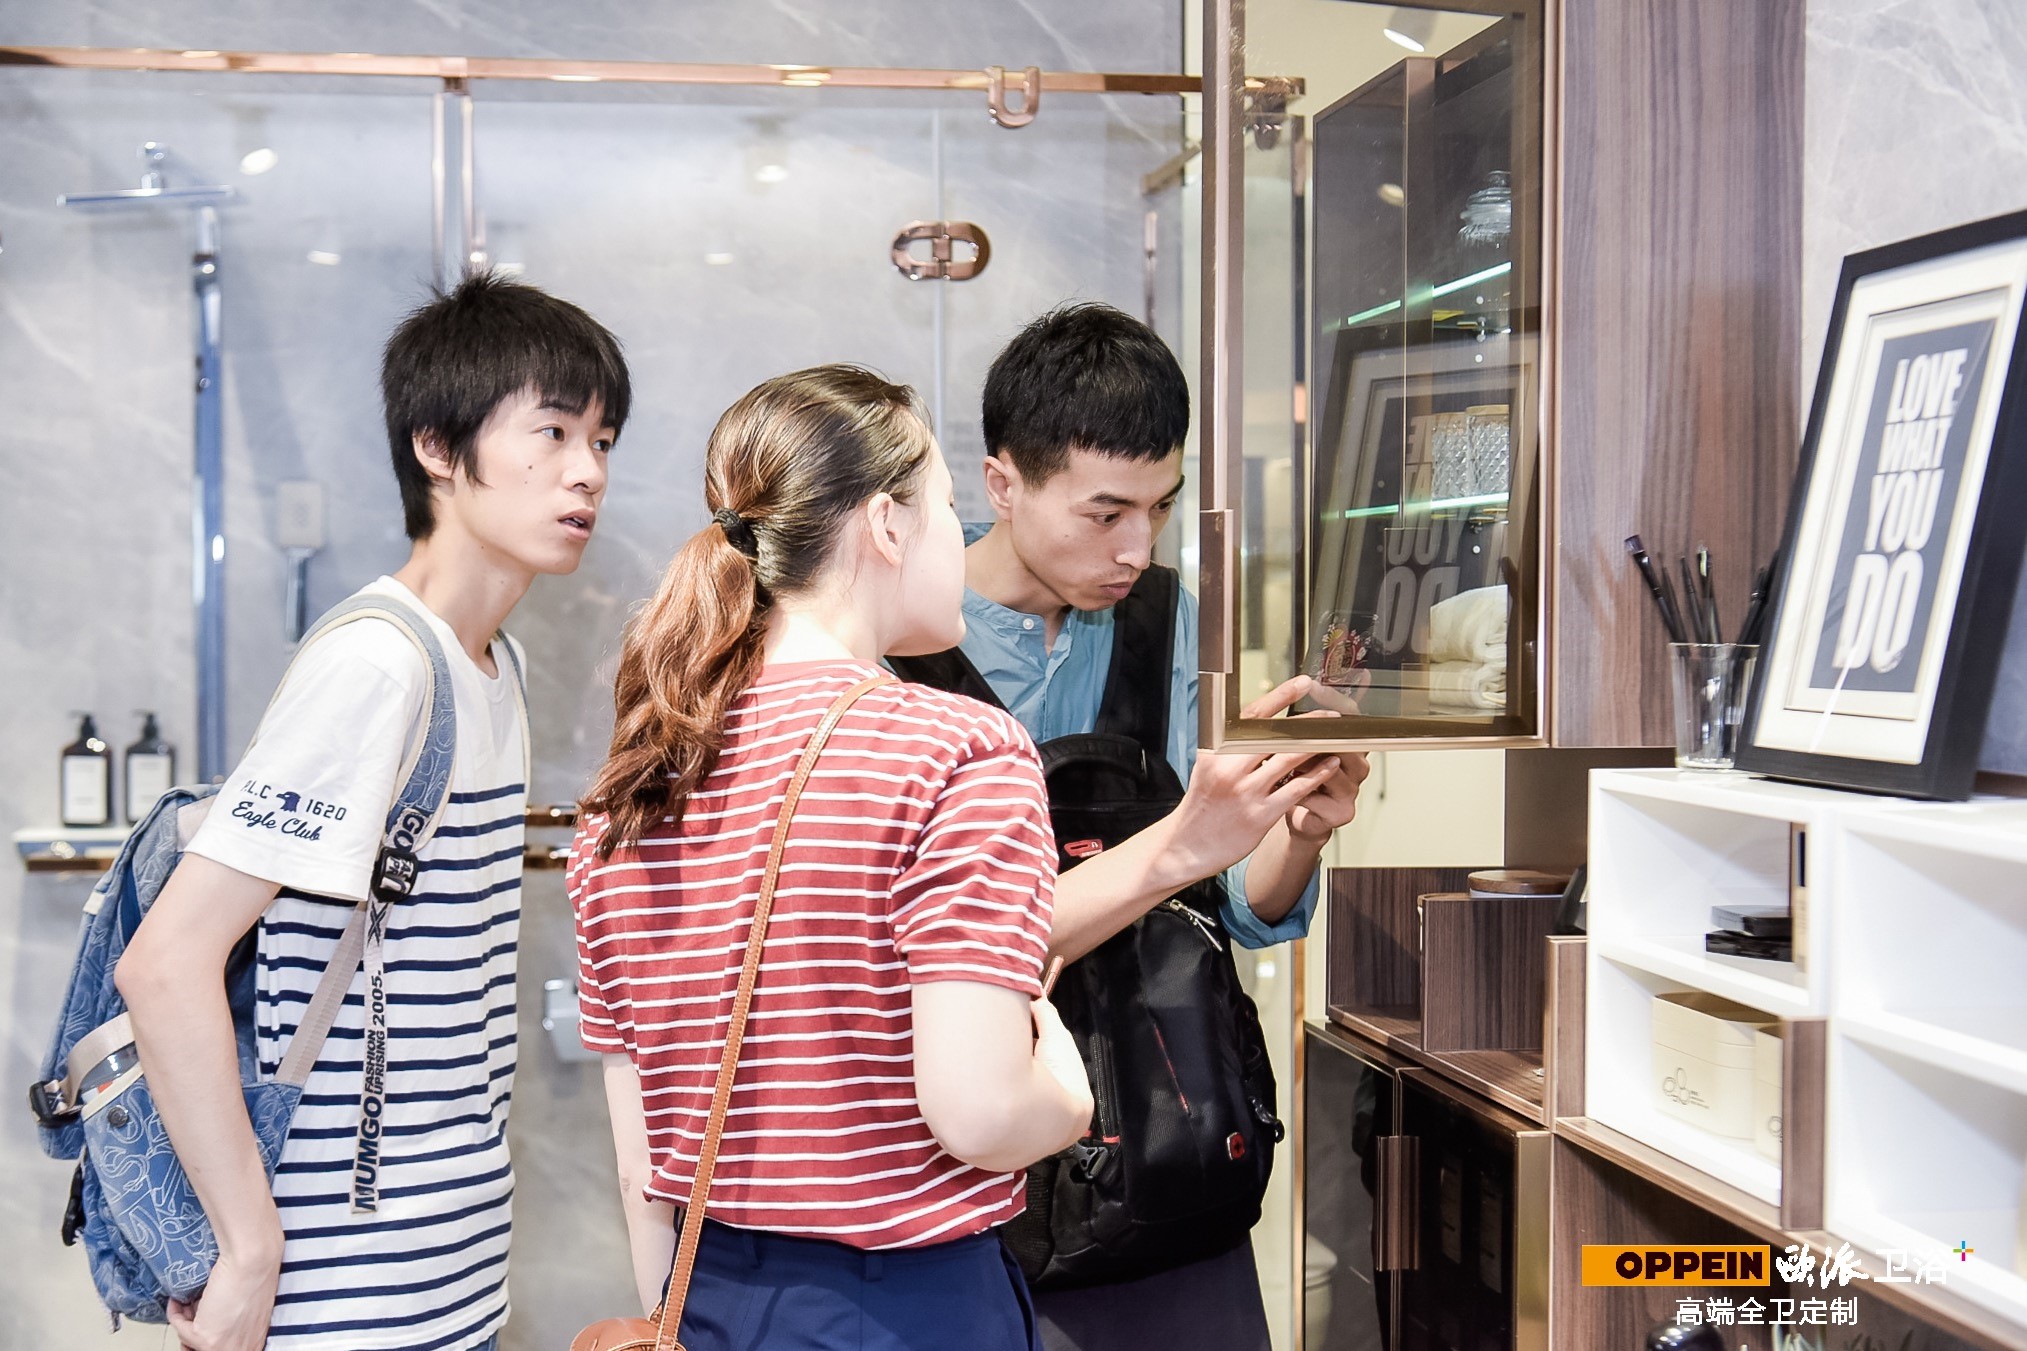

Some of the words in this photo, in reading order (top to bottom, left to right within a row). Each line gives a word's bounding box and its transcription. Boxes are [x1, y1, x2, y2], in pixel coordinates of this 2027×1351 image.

[1886, 348, 1968, 423] LOVE
[1877, 415, 1951, 474] WHAT
[1864, 468, 1945, 553] YOU
[1832, 550, 1924, 673] DO
[231, 801, 277, 828] Eagle
[281, 818, 323, 841] Club
[305, 799, 347, 821] 1620
[365, 1029, 376, 1092] FASHION
[373, 1030, 385, 1095] UPRISING
